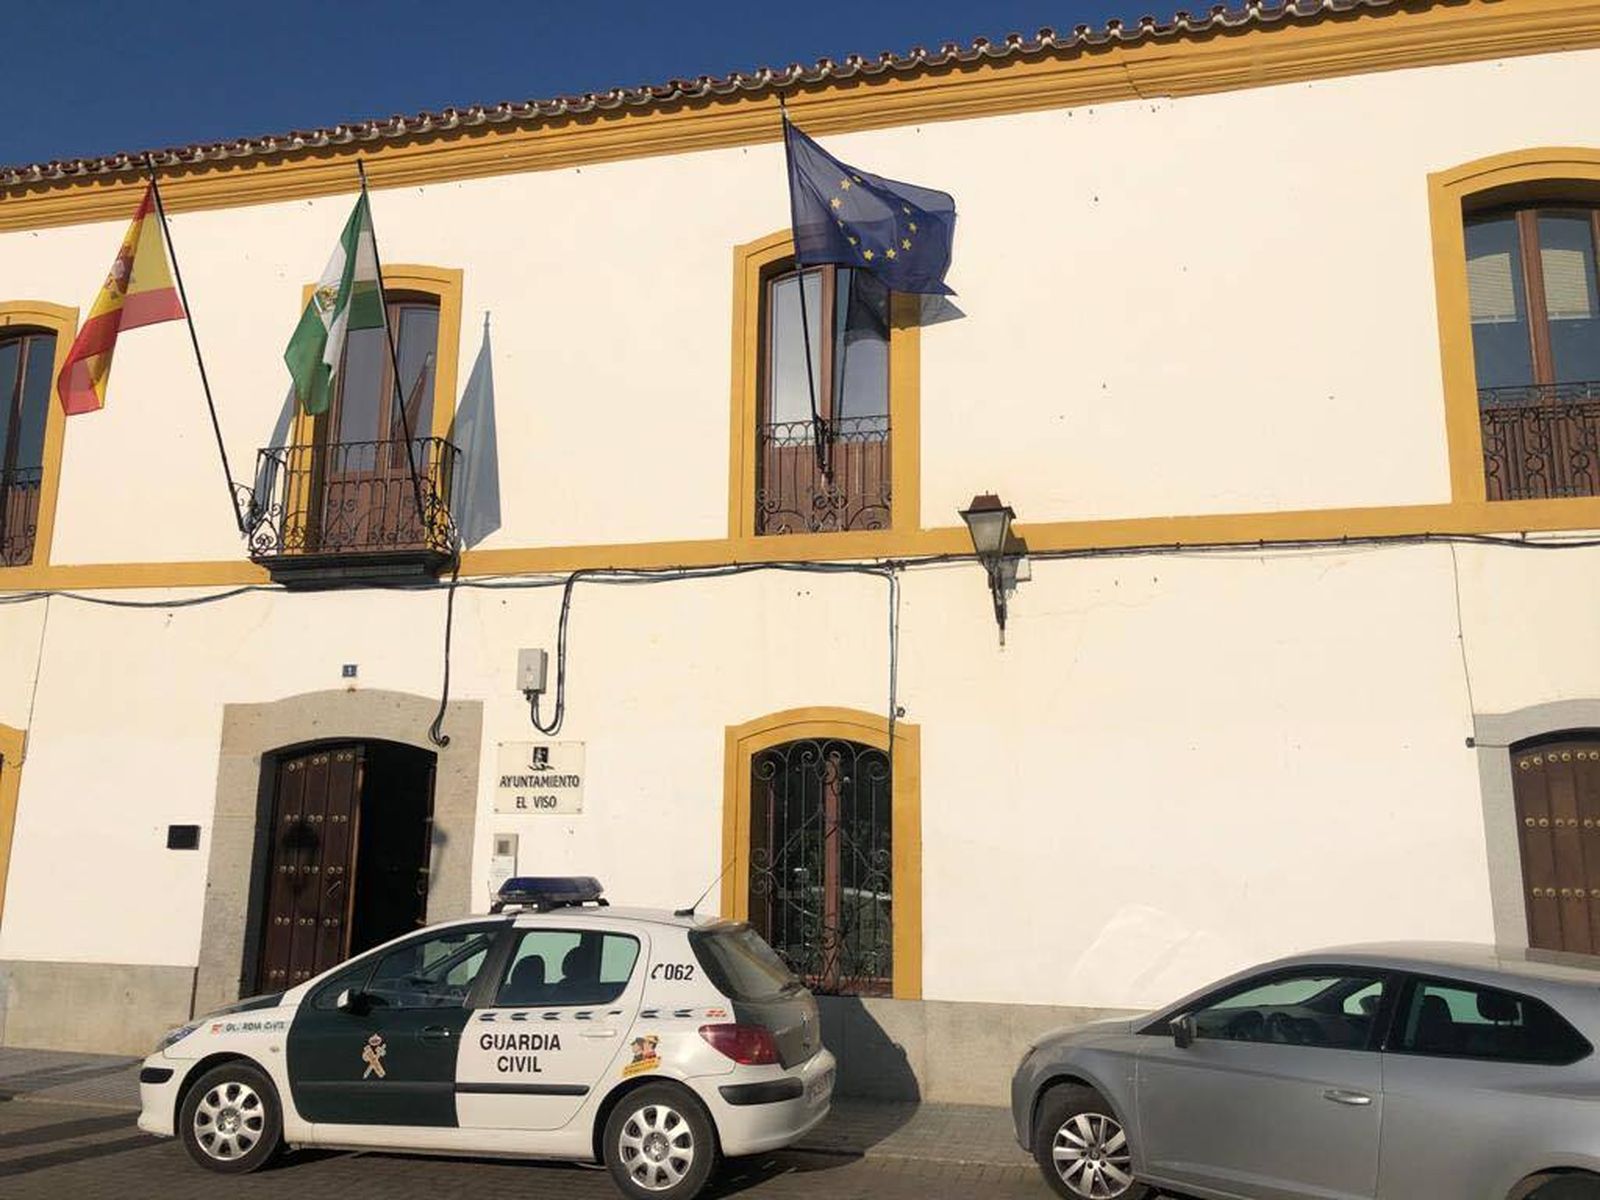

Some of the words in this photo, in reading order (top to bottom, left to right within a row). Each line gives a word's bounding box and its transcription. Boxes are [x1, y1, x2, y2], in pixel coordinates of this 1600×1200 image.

[499, 775, 580, 788] AYUNTAMIENTO
[516, 796, 527, 809] EL
[533, 795, 557, 809] VISO
[664, 963, 695, 981] 062
[479, 1033, 562, 1051] GUARDIA
[497, 1055, 542, 1073] CIVIL
